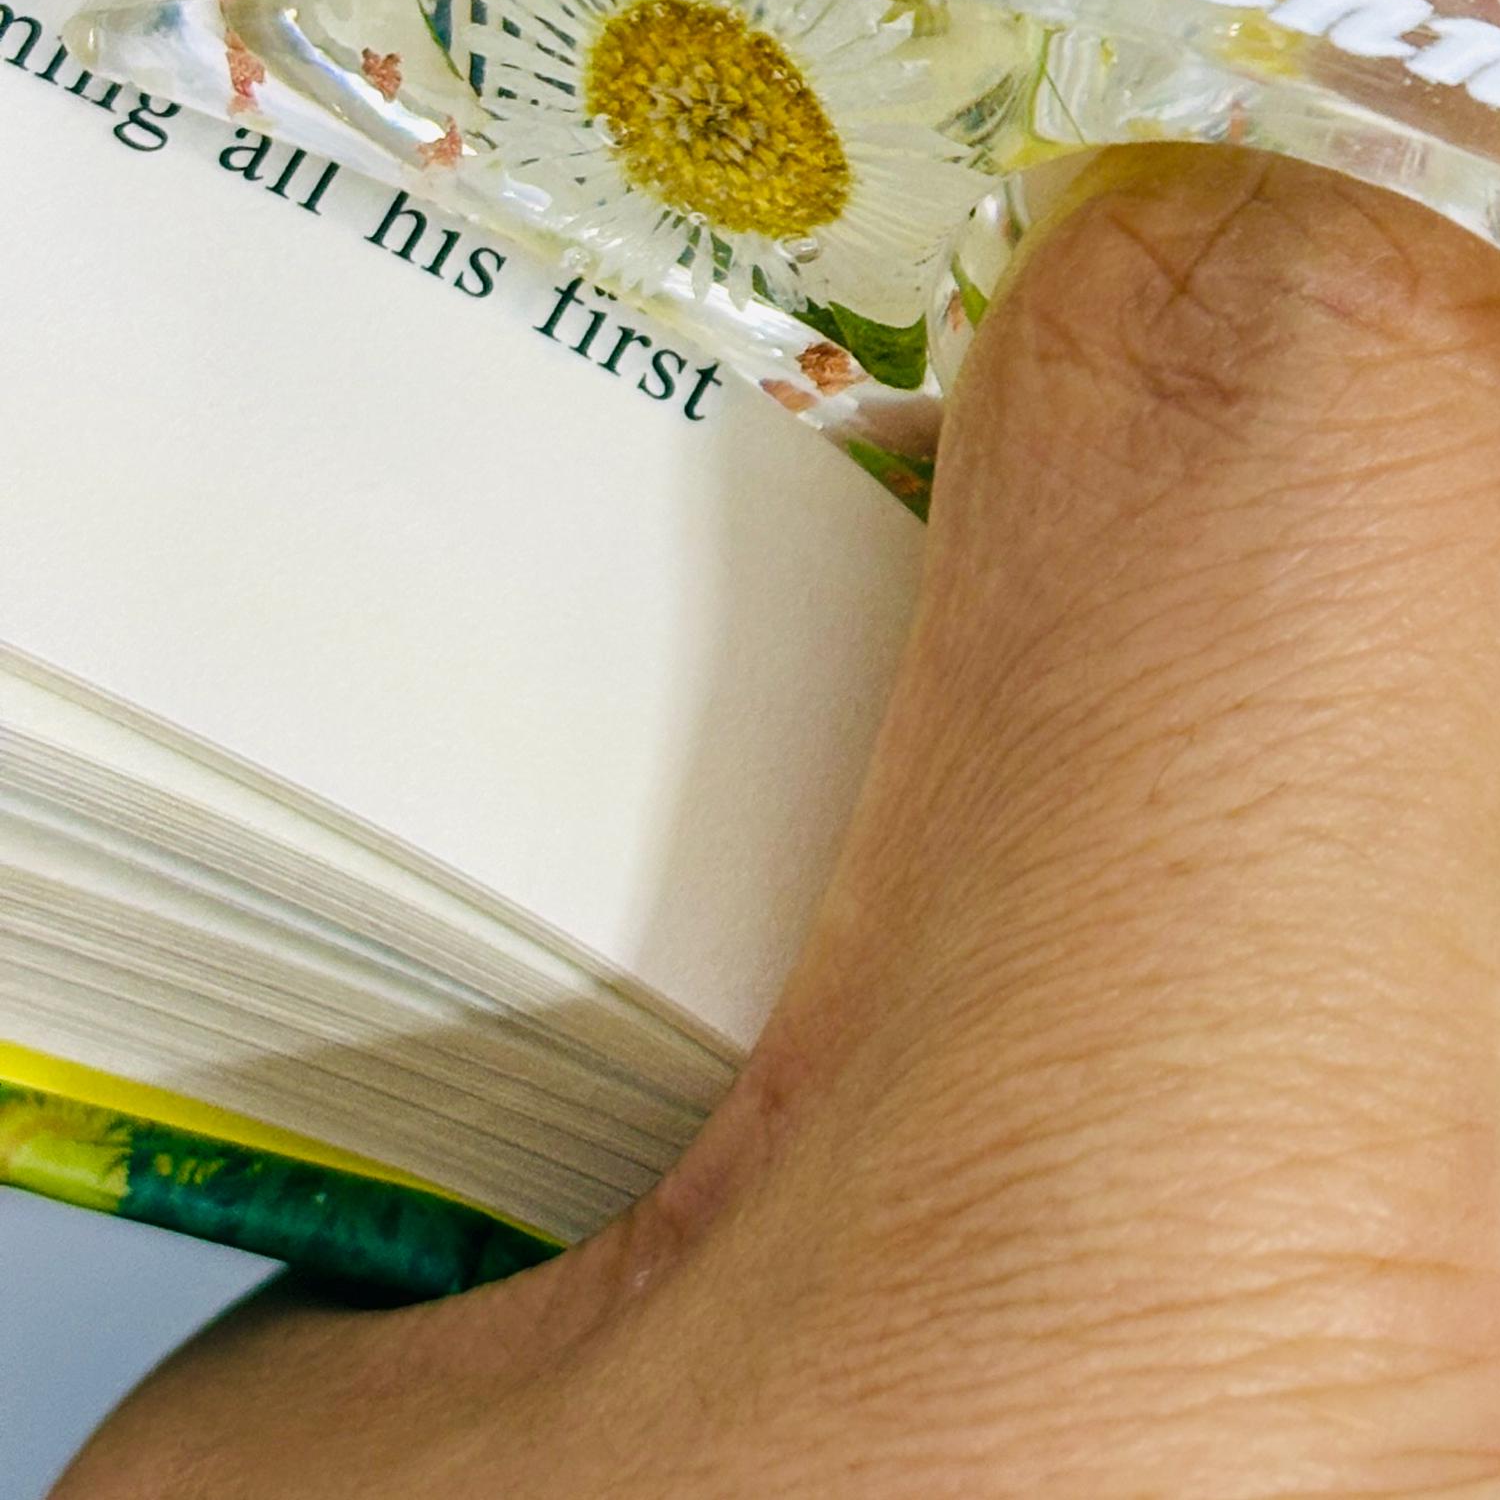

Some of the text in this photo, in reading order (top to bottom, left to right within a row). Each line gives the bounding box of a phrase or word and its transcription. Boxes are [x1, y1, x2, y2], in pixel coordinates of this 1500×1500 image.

[218, 126, 342, 217] all
[364, 190, 508, 300] his
[532, 274, 724, 422] first
